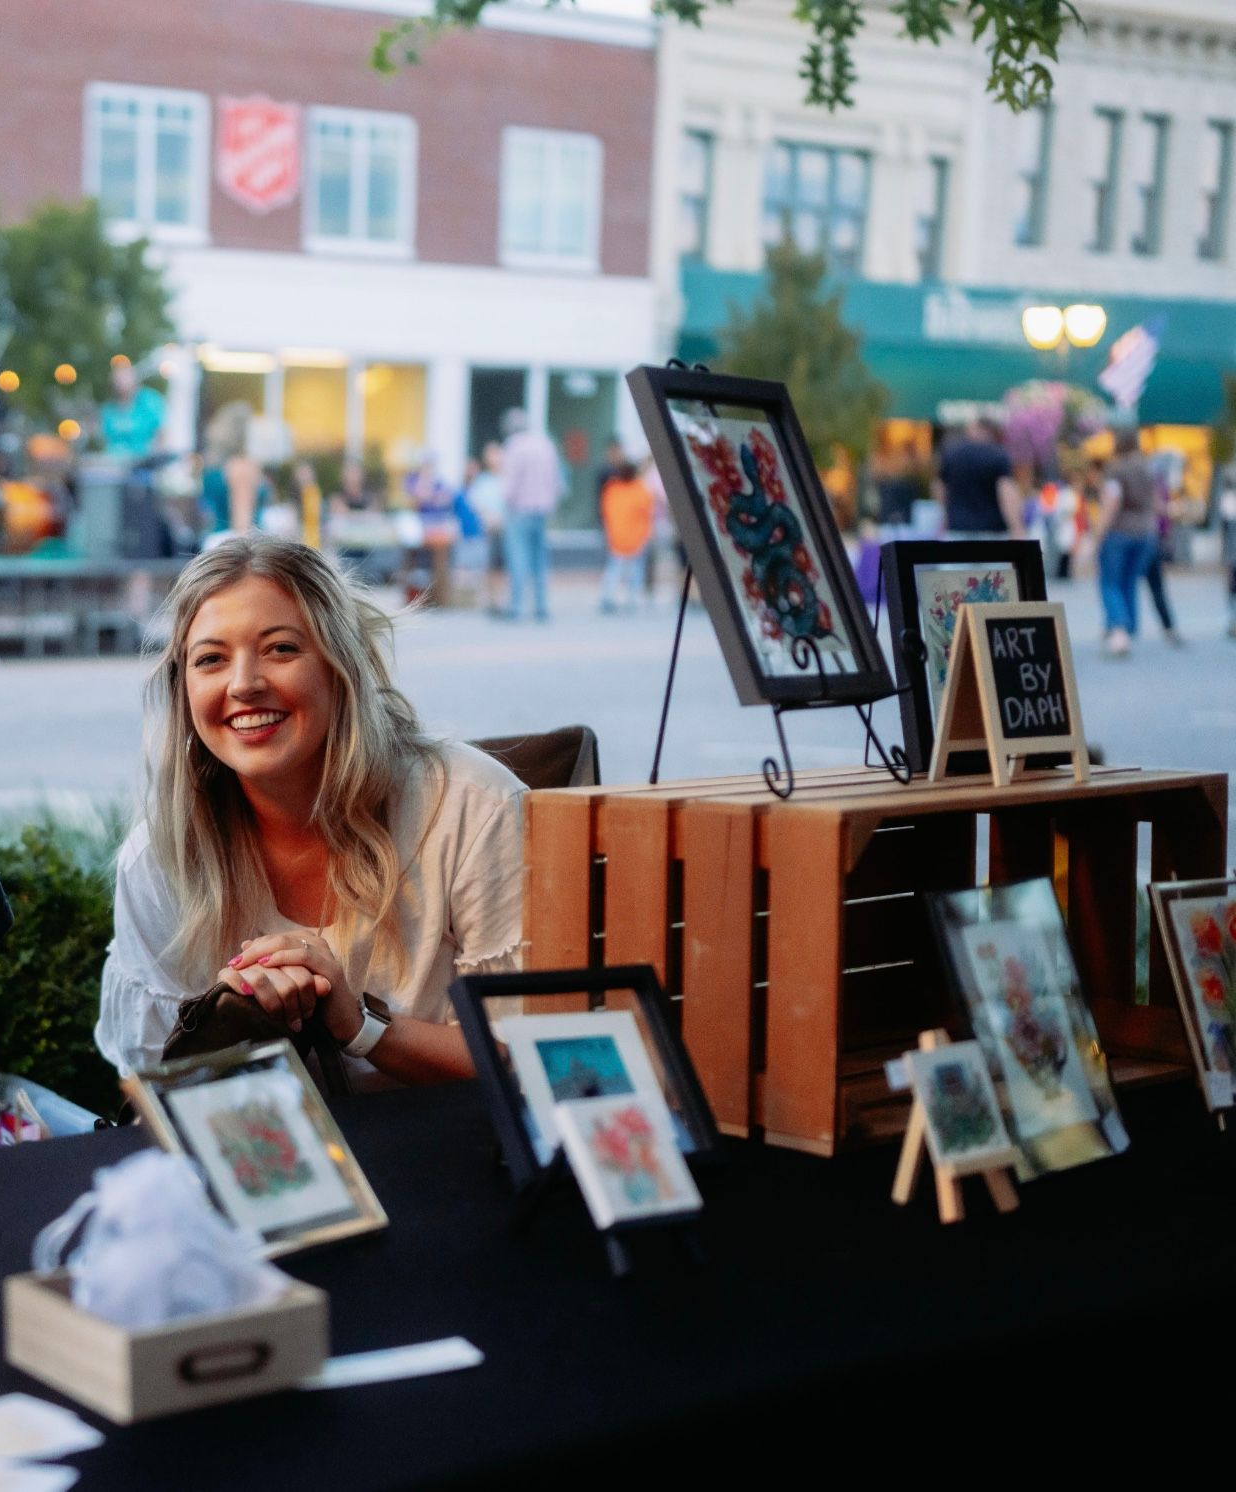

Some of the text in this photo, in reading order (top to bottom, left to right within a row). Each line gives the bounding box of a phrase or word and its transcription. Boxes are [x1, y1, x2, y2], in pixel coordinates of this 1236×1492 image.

[992, 627, 1036, 659] ART
[1019, 662, 1051, 692] BY
[1004, 693, 1064, 729] DAPH
